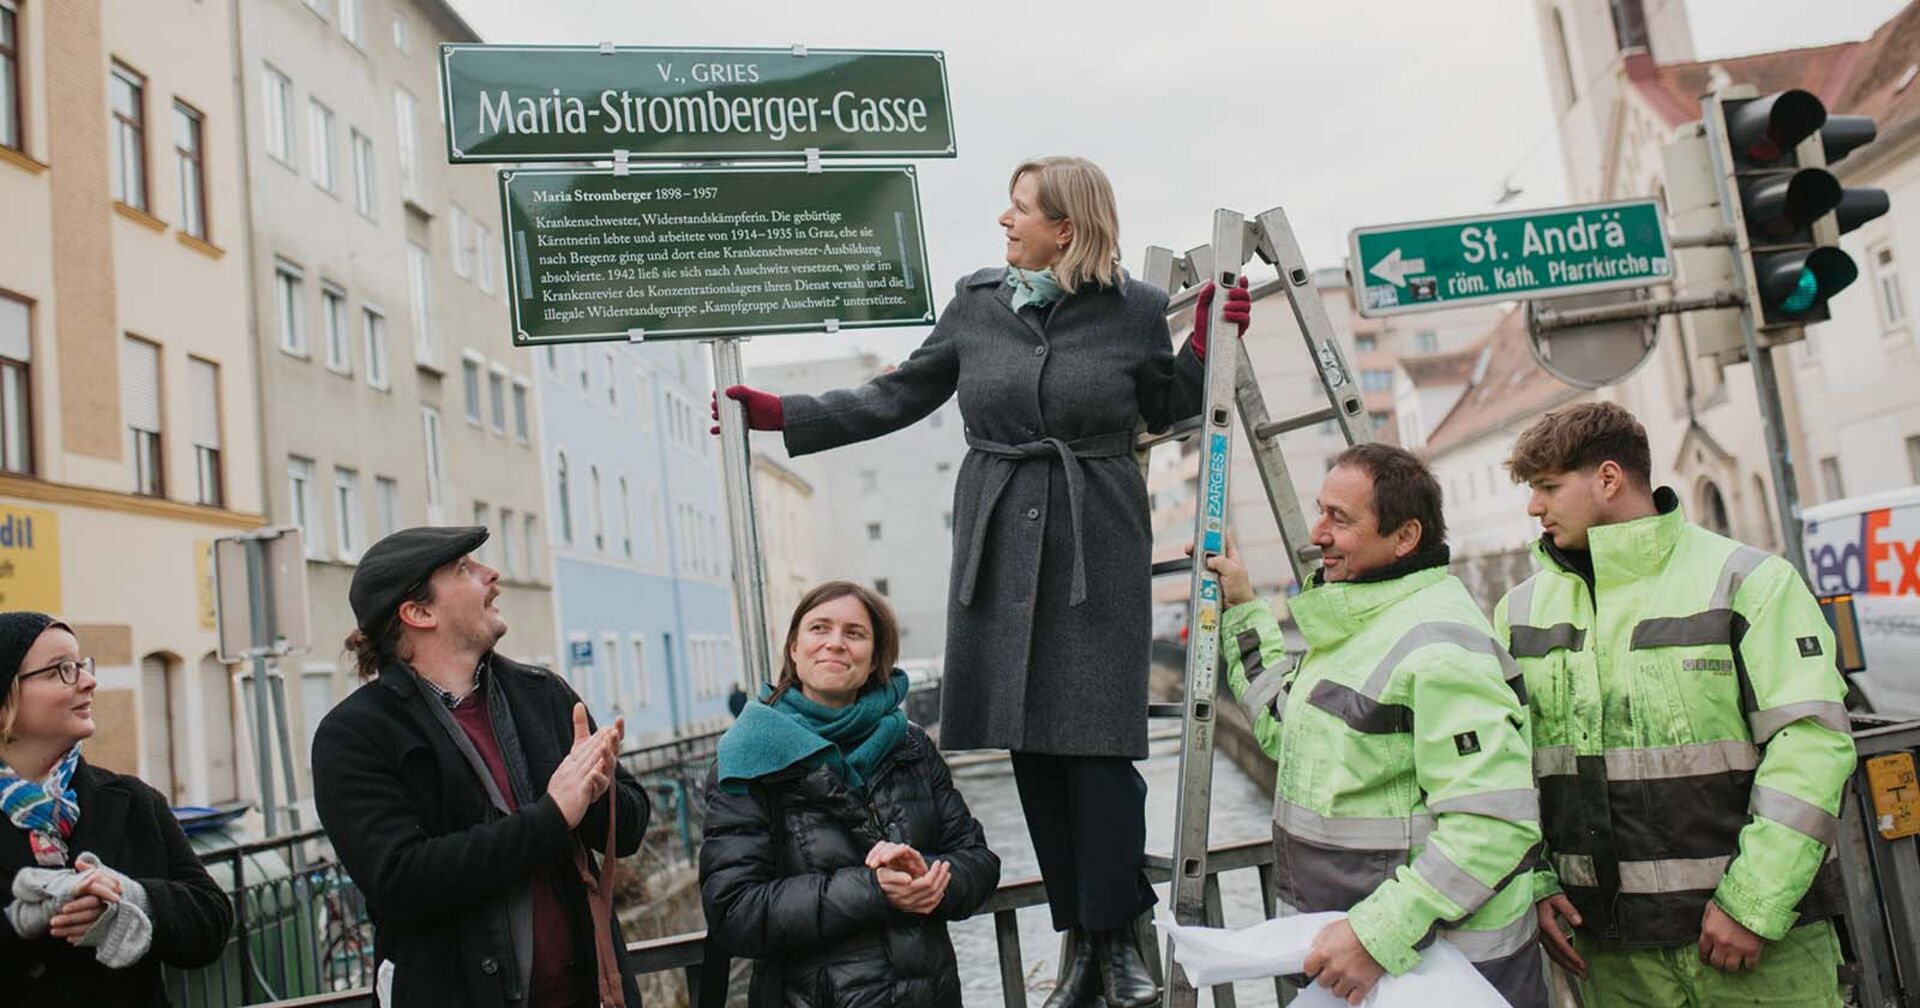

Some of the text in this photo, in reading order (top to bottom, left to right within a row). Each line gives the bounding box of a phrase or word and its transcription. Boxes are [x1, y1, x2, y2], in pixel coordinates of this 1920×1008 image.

[656, 64, 760, 84] V., GRIES
[479, 88, 926, 140] Maria-Stromberger-Gasse
[533, 190, 572, 202] Maria
[574, 188, 652, 204] Stromberger
[536, 210, 841, 229] Krankenschwester, Widerstandskämpferin. Die gebürtige
[537, 233, 600, 246] Kärntnerin
[602, 232, 631, 244] lebte
[633, 231, 655, 243] und
[658, 230, 705, 242] arbeitete
[794, 228, 806, 238] in
[808, 226, 838, 239] Graz,
[839, 226, 857, 237] ehe
[859, 226, 873, 236] sie
[1461, 213, 1625, 262] St. Andrä
[539, 242, 881, 266] nach Bregenz ging und dort eine Krankenschwester-Ausbildung
[540, 270, 605, 283] absolvierte.
[607, 268, 635, 280] 1942
[637, 266, 660, 279] ließ
[662, 267, 677, 278] sie
[679, 265, 701, 277] sich
[704, 264, 730, 276] nach
[733, 263, 789, 275] Auschwitz
[791, 264, 843, 273] versetzen,
[862, 260, 875, 271] sie
[877, 260, 891, 270] im
[1448, 272, 1489, 295] röm.
[1494, 266, 1538, 288] Kath.
[1548, 255, 1648, 281] Pfarrkirche
[542, 276, 904, 302] Krankenrevier des Konzentrationslagers ihren Dienst versah und die
[544, 307, 584, 323] illegale
[586, 303, 697, 318] Widerstandsgruppe
[842, 294, 906, 306] unterstützte.
[1208, 452, 1224, 515] ZARGES
